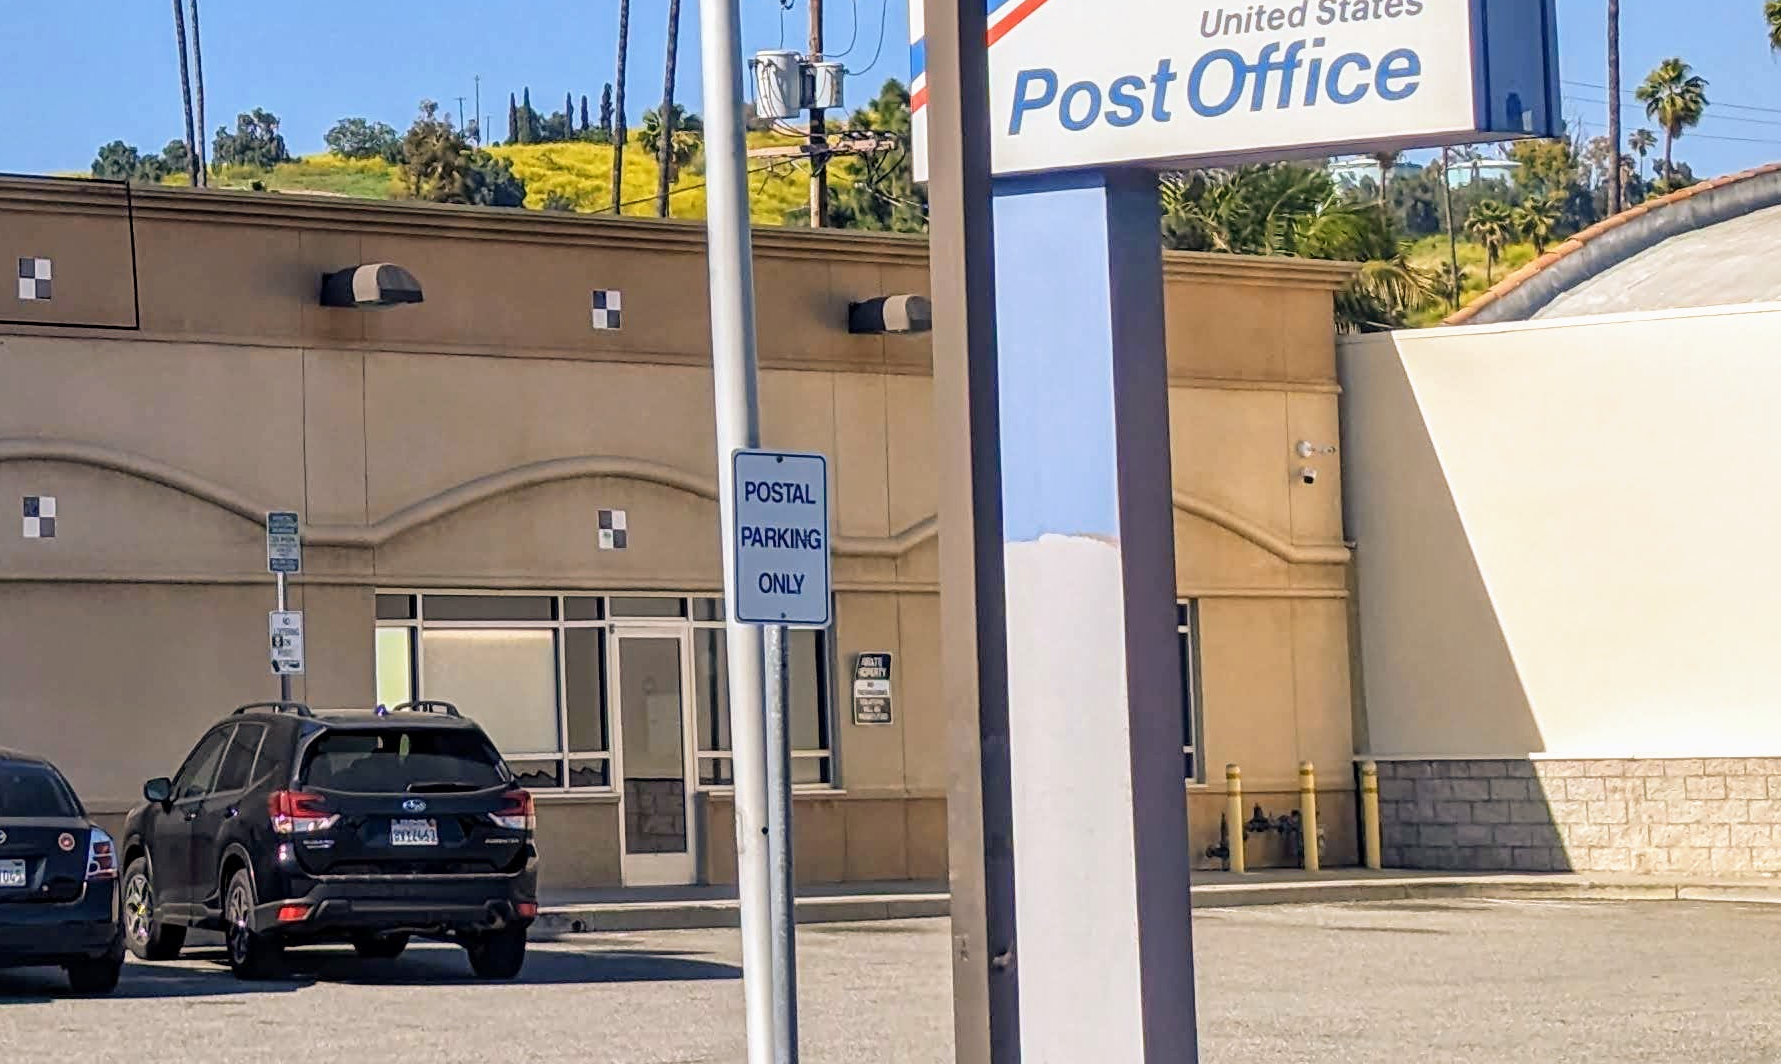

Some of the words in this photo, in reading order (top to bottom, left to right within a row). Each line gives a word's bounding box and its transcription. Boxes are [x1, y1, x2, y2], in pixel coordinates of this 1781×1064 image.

[1200, 0, 1308, 38] United
[1008, 58, 1177, 136] Post
[1187, 37, 1422, 117] Office
[745, 481, 816, 504] POSTAL
[741, 526, 822, 550] PARKING
[758, 572, 805, 595] ONLY
